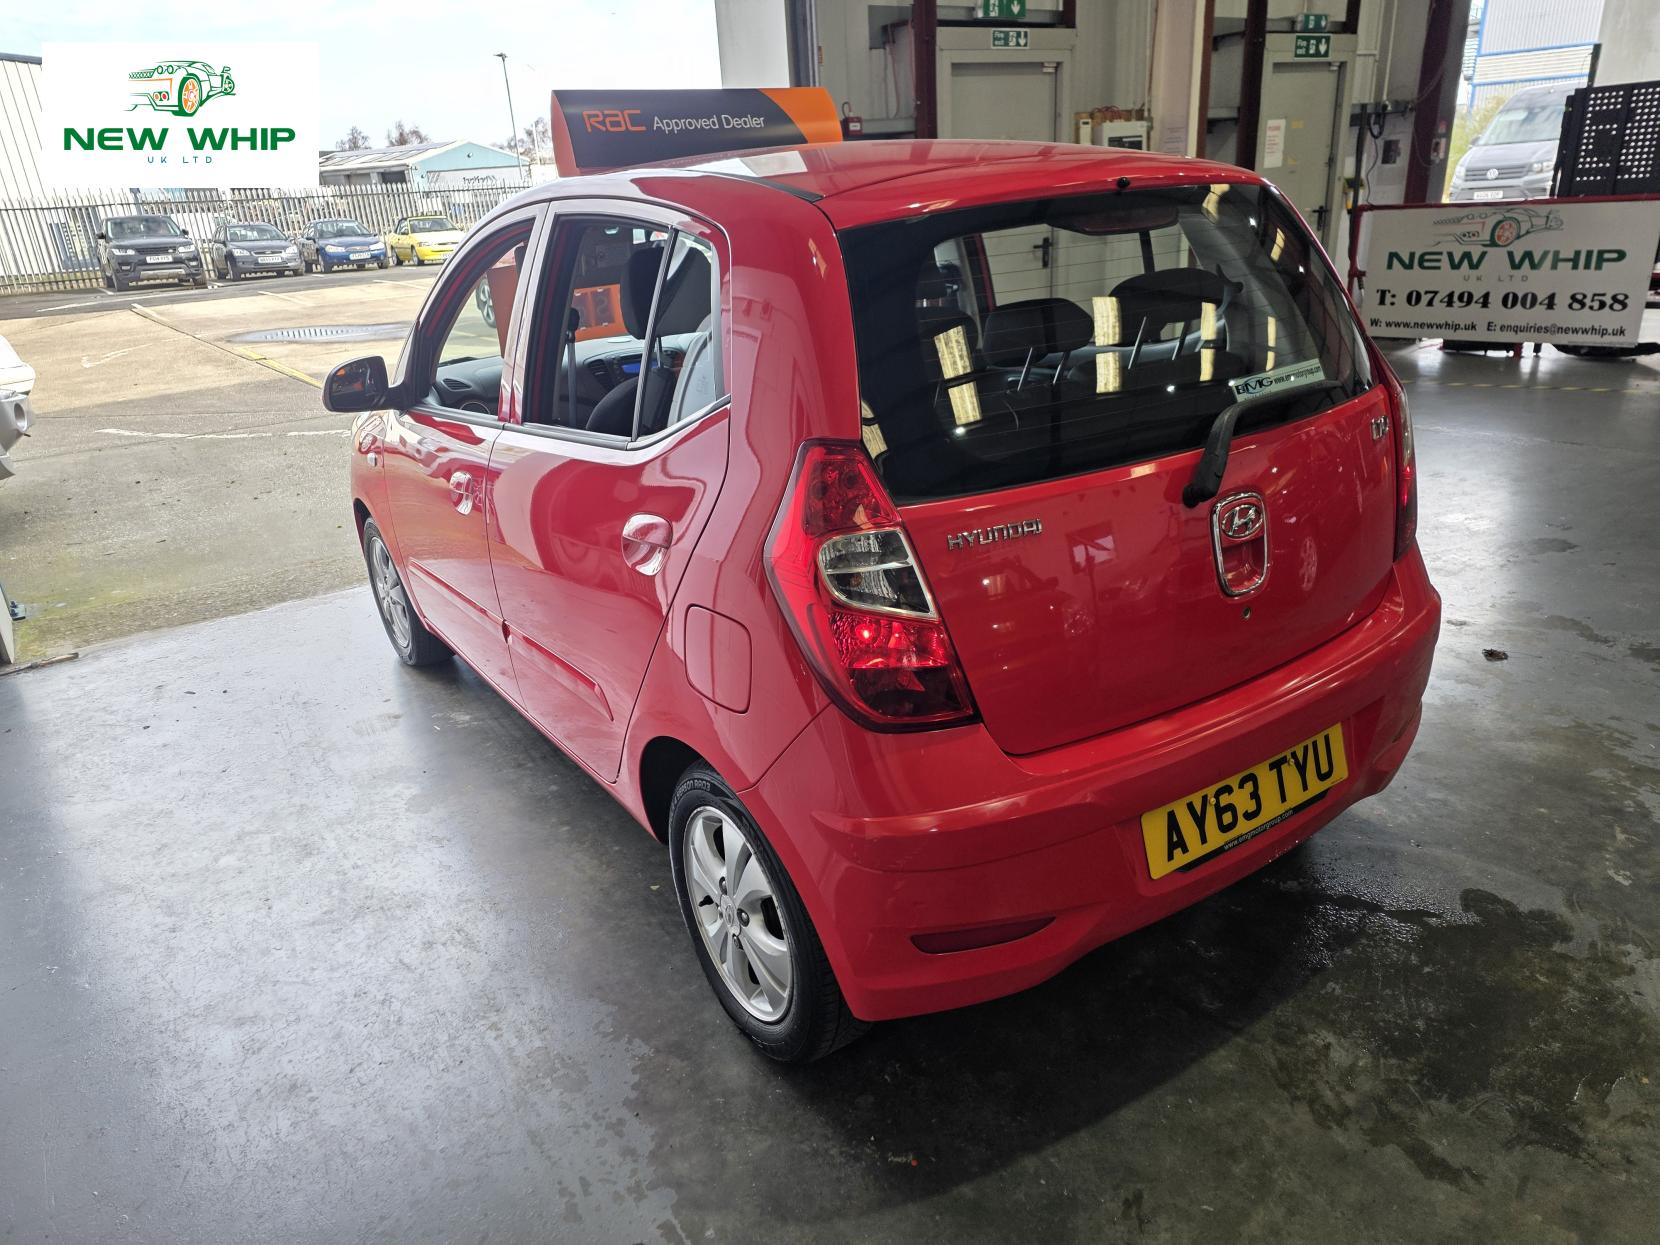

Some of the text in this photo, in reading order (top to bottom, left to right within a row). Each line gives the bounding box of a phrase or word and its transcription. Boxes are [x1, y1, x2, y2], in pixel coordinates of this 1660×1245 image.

[653, 114, 719, 134] Approved
[720, 114, 765, 129] Dealer
[1386, 249, 1627, 271] NEW WHIP
[1377, 289, 1629, 312] T: 07494 004 858
[1370, 317, 1627, 338] W: www.newwhip.uk E: enquiries@newwhip.uk
[947, 518, 1042, 551] HYUNDAI
[1167, 733, 1334, 862] AY63 TYU
[1223, 809, 1294, 850] www.emgmotorgroup.com
